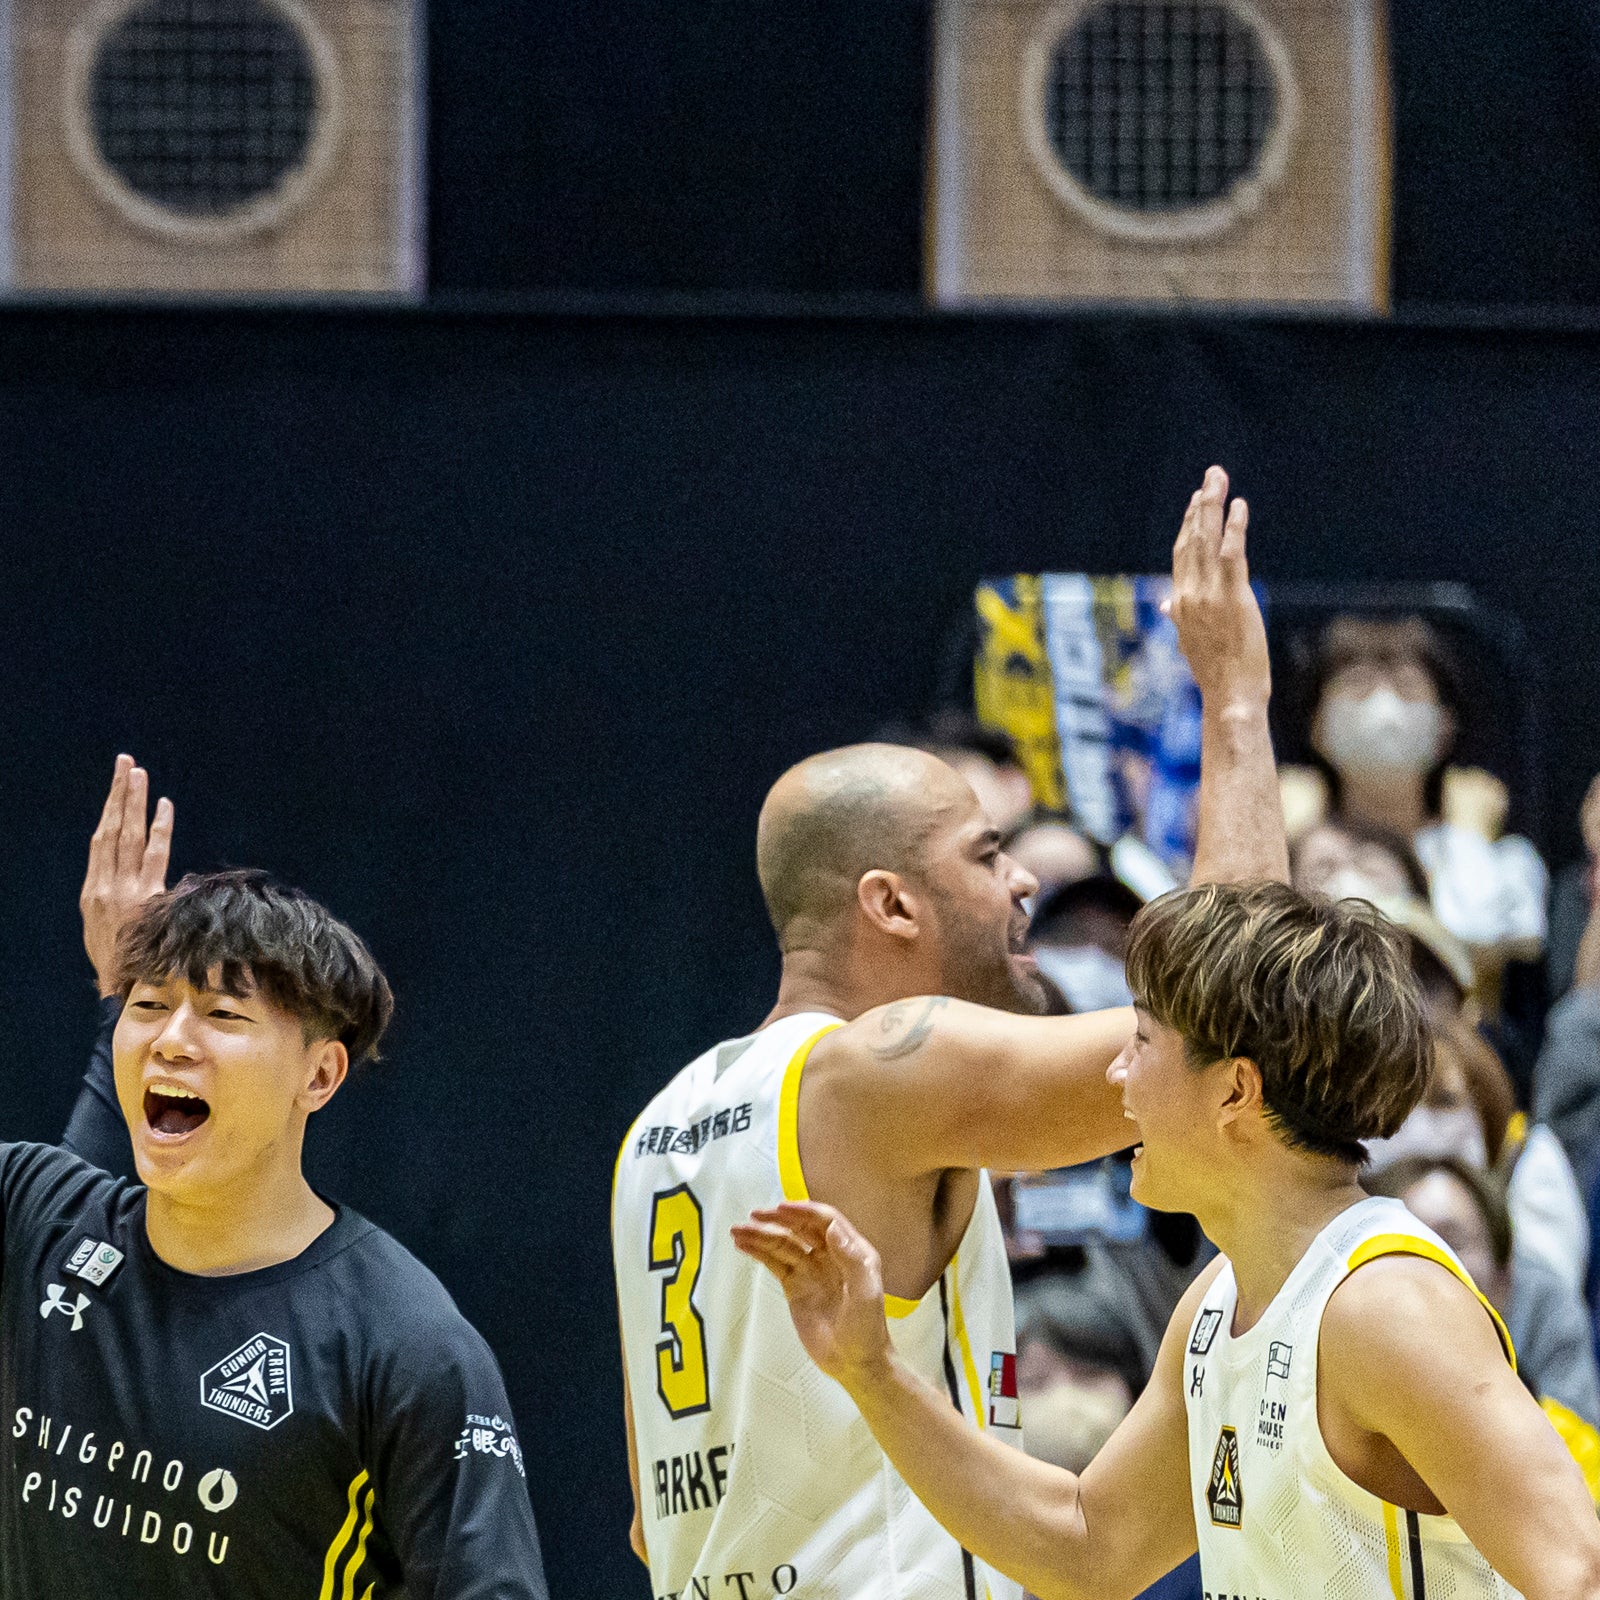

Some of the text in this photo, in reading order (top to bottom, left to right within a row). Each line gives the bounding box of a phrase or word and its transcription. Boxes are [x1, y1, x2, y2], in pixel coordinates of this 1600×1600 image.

[648, 1182, 711, 1420] 3
[220, 1339, 268, 1378] GUNMA
[267, 1348, 286, 1395] CRANE
[207, 1388, 273, 1424] THUNDERS
